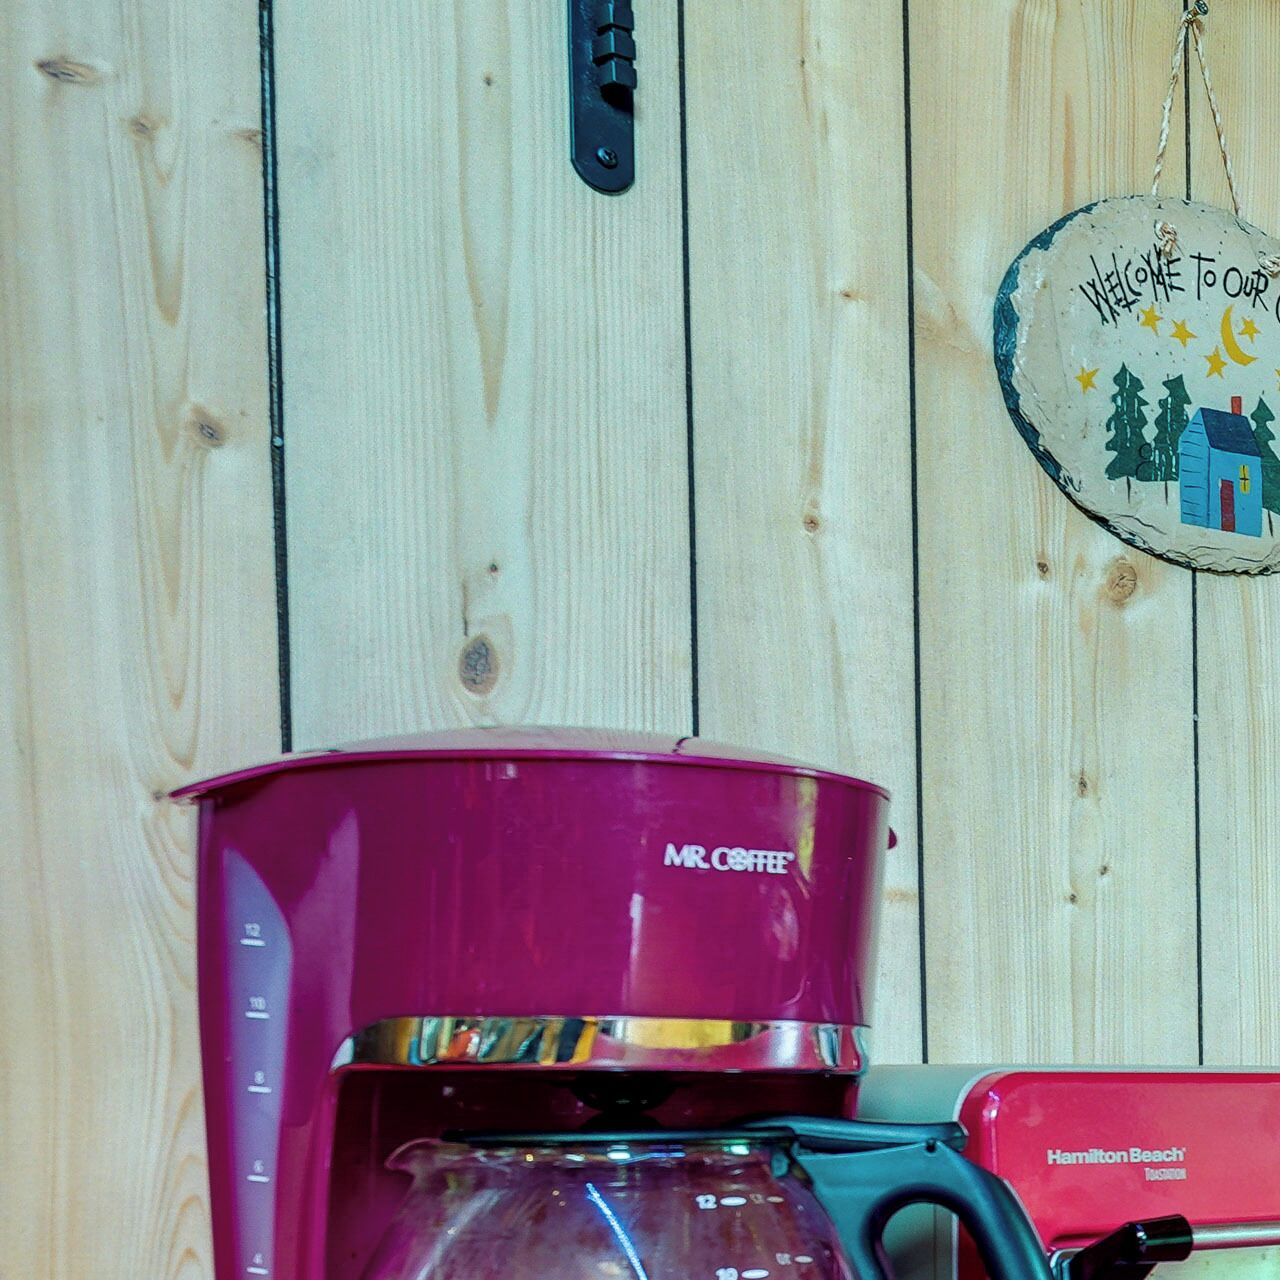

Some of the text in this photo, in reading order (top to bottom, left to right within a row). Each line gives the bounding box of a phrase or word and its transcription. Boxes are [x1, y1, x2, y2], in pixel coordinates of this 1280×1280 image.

[1079, 244, 1185, 327] WELCOME
[711, 846, 790, 874] COFFEE
[1046, 1147, 1185, 1165] Hamilton Beach
